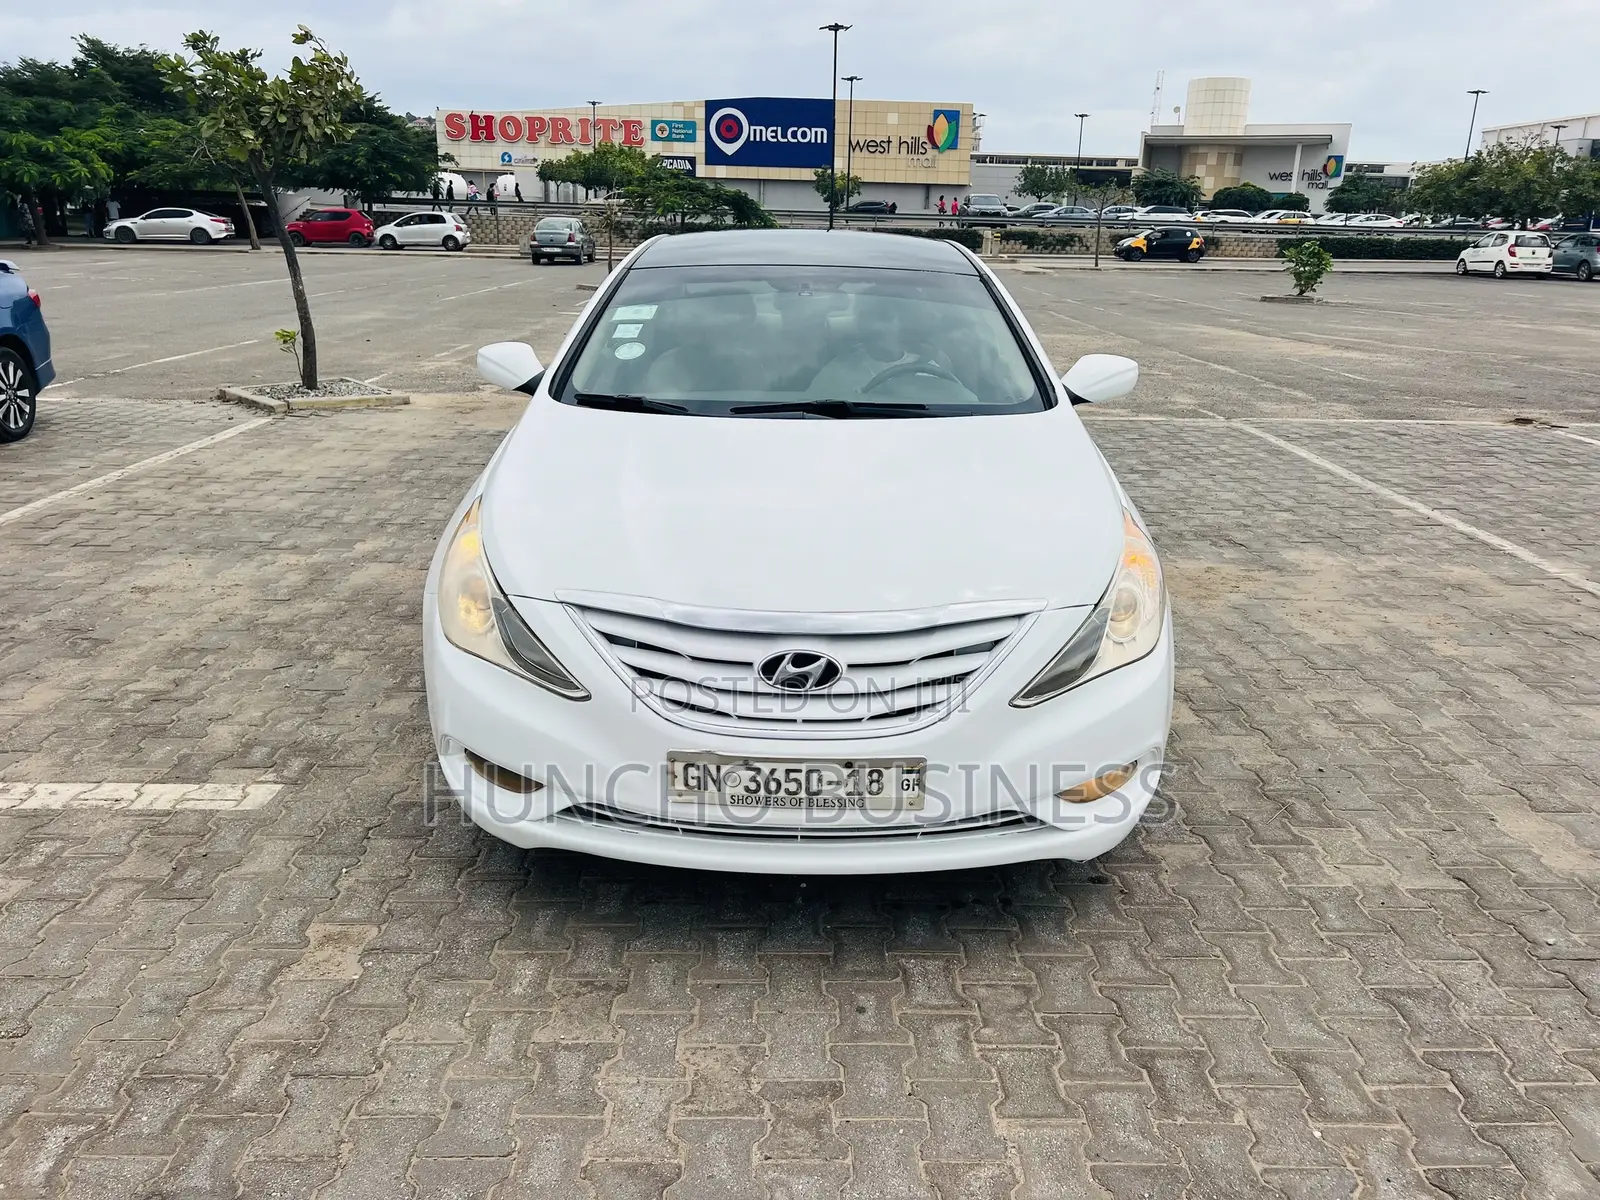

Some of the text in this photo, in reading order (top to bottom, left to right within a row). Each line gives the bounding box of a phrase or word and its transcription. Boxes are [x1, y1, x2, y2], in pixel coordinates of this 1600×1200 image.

[444, 112, 646, 147] SHOPRITE
[750, 125, 828, 143] MELCOM
[850, 135, 928, 155] west hills
[908, 155, 937, 168] mall
[1268, 169, 1323, 181] wes hills
[1307, 180, 1328, 189] mall
[682, 762, 722, 792] GN
[729, 794, 865, 809] SHOWERS OF BLESSING
